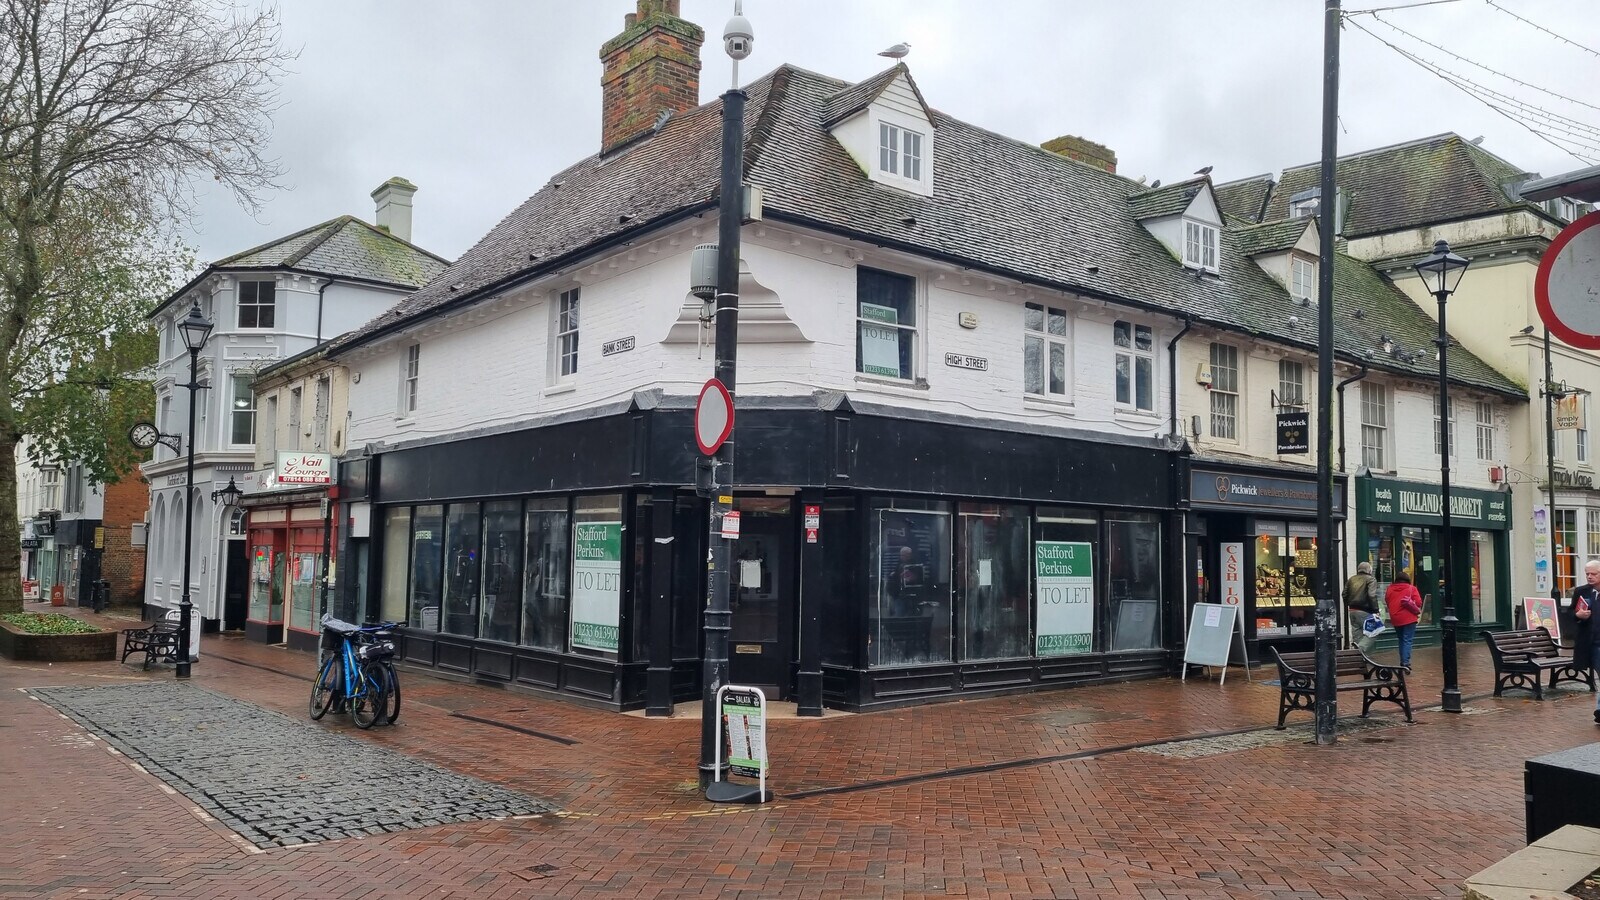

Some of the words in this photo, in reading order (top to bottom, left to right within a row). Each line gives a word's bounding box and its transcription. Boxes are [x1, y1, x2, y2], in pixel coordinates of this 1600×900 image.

[863, 307, 886, 317] Stafford
[863, 327, 878, 339] TO
[880, 329, 897, 341] LET
[603, 342, 616, 354] BANK
[616, 337, 634, 351] STREET
[947, 354, 963, 366] HIGH
[965, 357, 987, 369] STREET
[1556, 415, 1579, 424] Simply
[286, 455, 323, 467] Nail
[284, 466, 328, 477] Lounge
[1554, 470, 1572, 486] mply
[1573, 470, 1592, 487] Vape
[1231, 484, 1258, 496] Pickwick
[1375, 488, 1393, 500] health
[1376, 501, 1392, 513] foods
[1398, 490, 1439, 514] HOLLAND
[1449, 496, 1483, 520] BARRETT
[577, 526, 607, 541] Stafford
[577, 543, 604, 558] Perkins
[1037, 545, 1074, 559] Stafford
[1039, 561, 1073, 574] Perkins
[1226, 545, 1239, 582] CASH
[576, 571, 593, 590] TO
[596, 572, 620, 591] LET
[1041, 587, 1062, 604] TO
[1065, 587, 1091, 604] LET
[574, 622, 594, 638] 01233
[594, 625, 619, 641] 613900
[1038, 636, 1063, 648] 01233
[1064, 634, 1091, 647] 613900
[735, 695, 752, 704] SALATA
